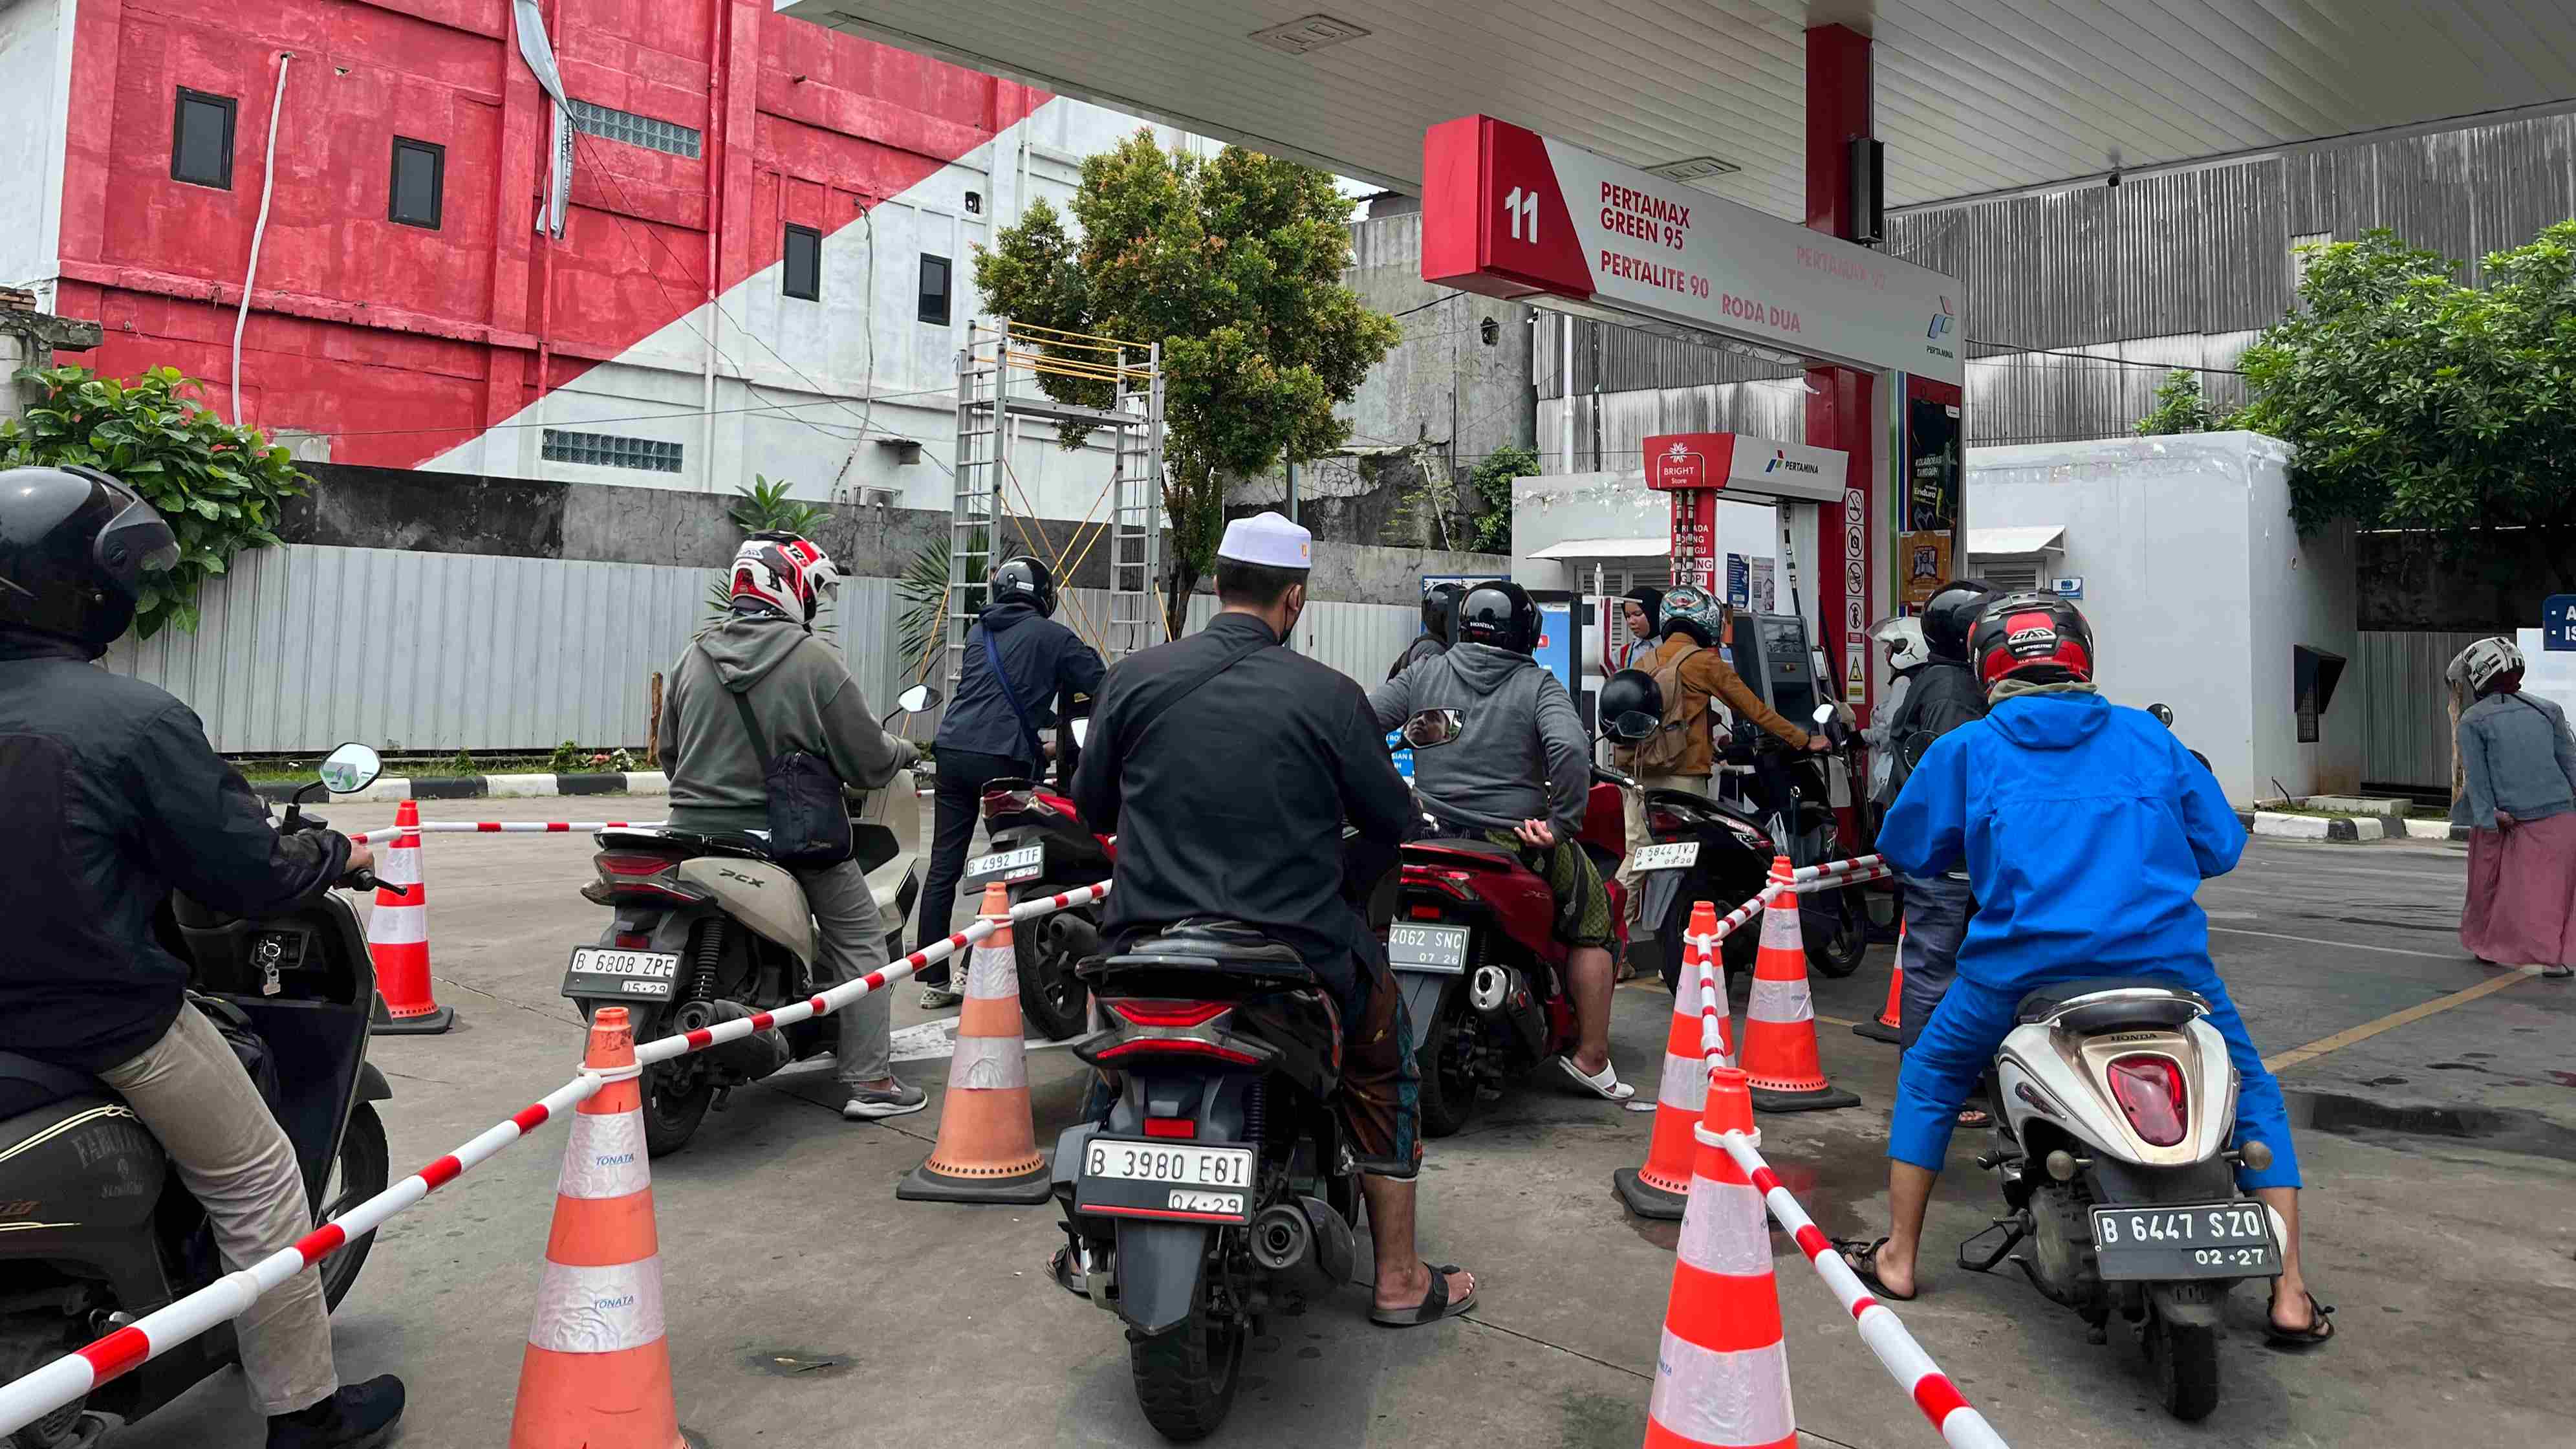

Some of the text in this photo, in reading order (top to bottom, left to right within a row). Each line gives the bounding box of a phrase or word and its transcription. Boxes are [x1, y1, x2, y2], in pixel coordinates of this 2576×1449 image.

[1601, 180, 1691, 229] PERTAMAX
[1505, 186, 1539, 244] 11
[1601, 208, 1683, 250] GREEN 95
[1601, 250, 1709, 299] PERTALITE 90
[1722, 294, 1801, 333] RODA DUA
[1926, 345, 1954, 358] PERTAMINA
[1664, 466, 1694, 476] BRIGHT
[1784, 460, 1819, 474] PERTAMINA
[1470, 622, 1495, 630] HONDA
[2015, 643, 2053, 653] SUPREME
[1636, 848, 1643, 858] B
[1676, 844, 1696, 854] TVJ
[968, 848, 1039, 875] B 4992 TTF
[1391, 929, 1425, 946] 4062
[576, 953, 675, 977] B 6808 ZPE
[1419, 952, 1435, 963] 07
[595, 1153, 634, 1166] TONATA
[1090, 1148, 1106, 1176] B
[1122, 1150, 1185, 1180] 3980
[2102, 1217, 2118, 1243] B
[2131, 1213, 2193, 1241] 6447
[594, 1295, 634, 1311] TONATA
